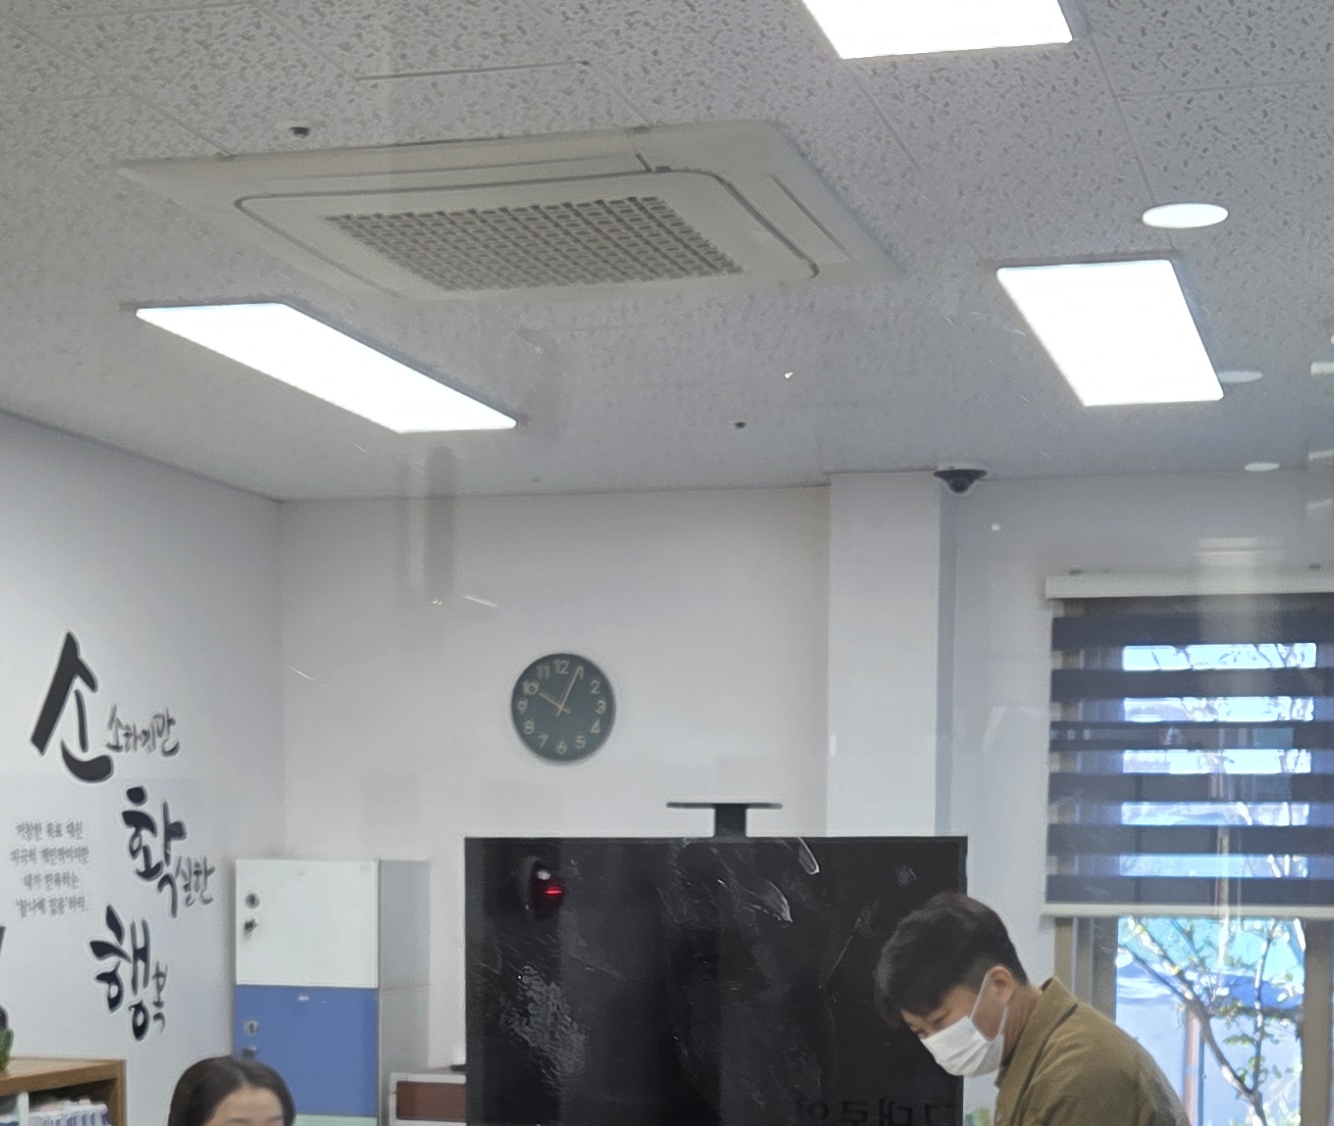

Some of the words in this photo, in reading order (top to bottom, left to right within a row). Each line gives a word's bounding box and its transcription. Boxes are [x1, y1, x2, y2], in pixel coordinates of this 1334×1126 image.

[553, 658, 570, 675] 12
[522, 680, 540, 696] 10
[590, 677, 601, 695] 2
[595, 700, 607, 715] 3
[524, 720, 535, 735] 8
[590, 719, 601, 735] 4
[538, 734, 549, 749] 7
[556, 740, 568, 755] 6
[575, 734, 587, 749] 5
